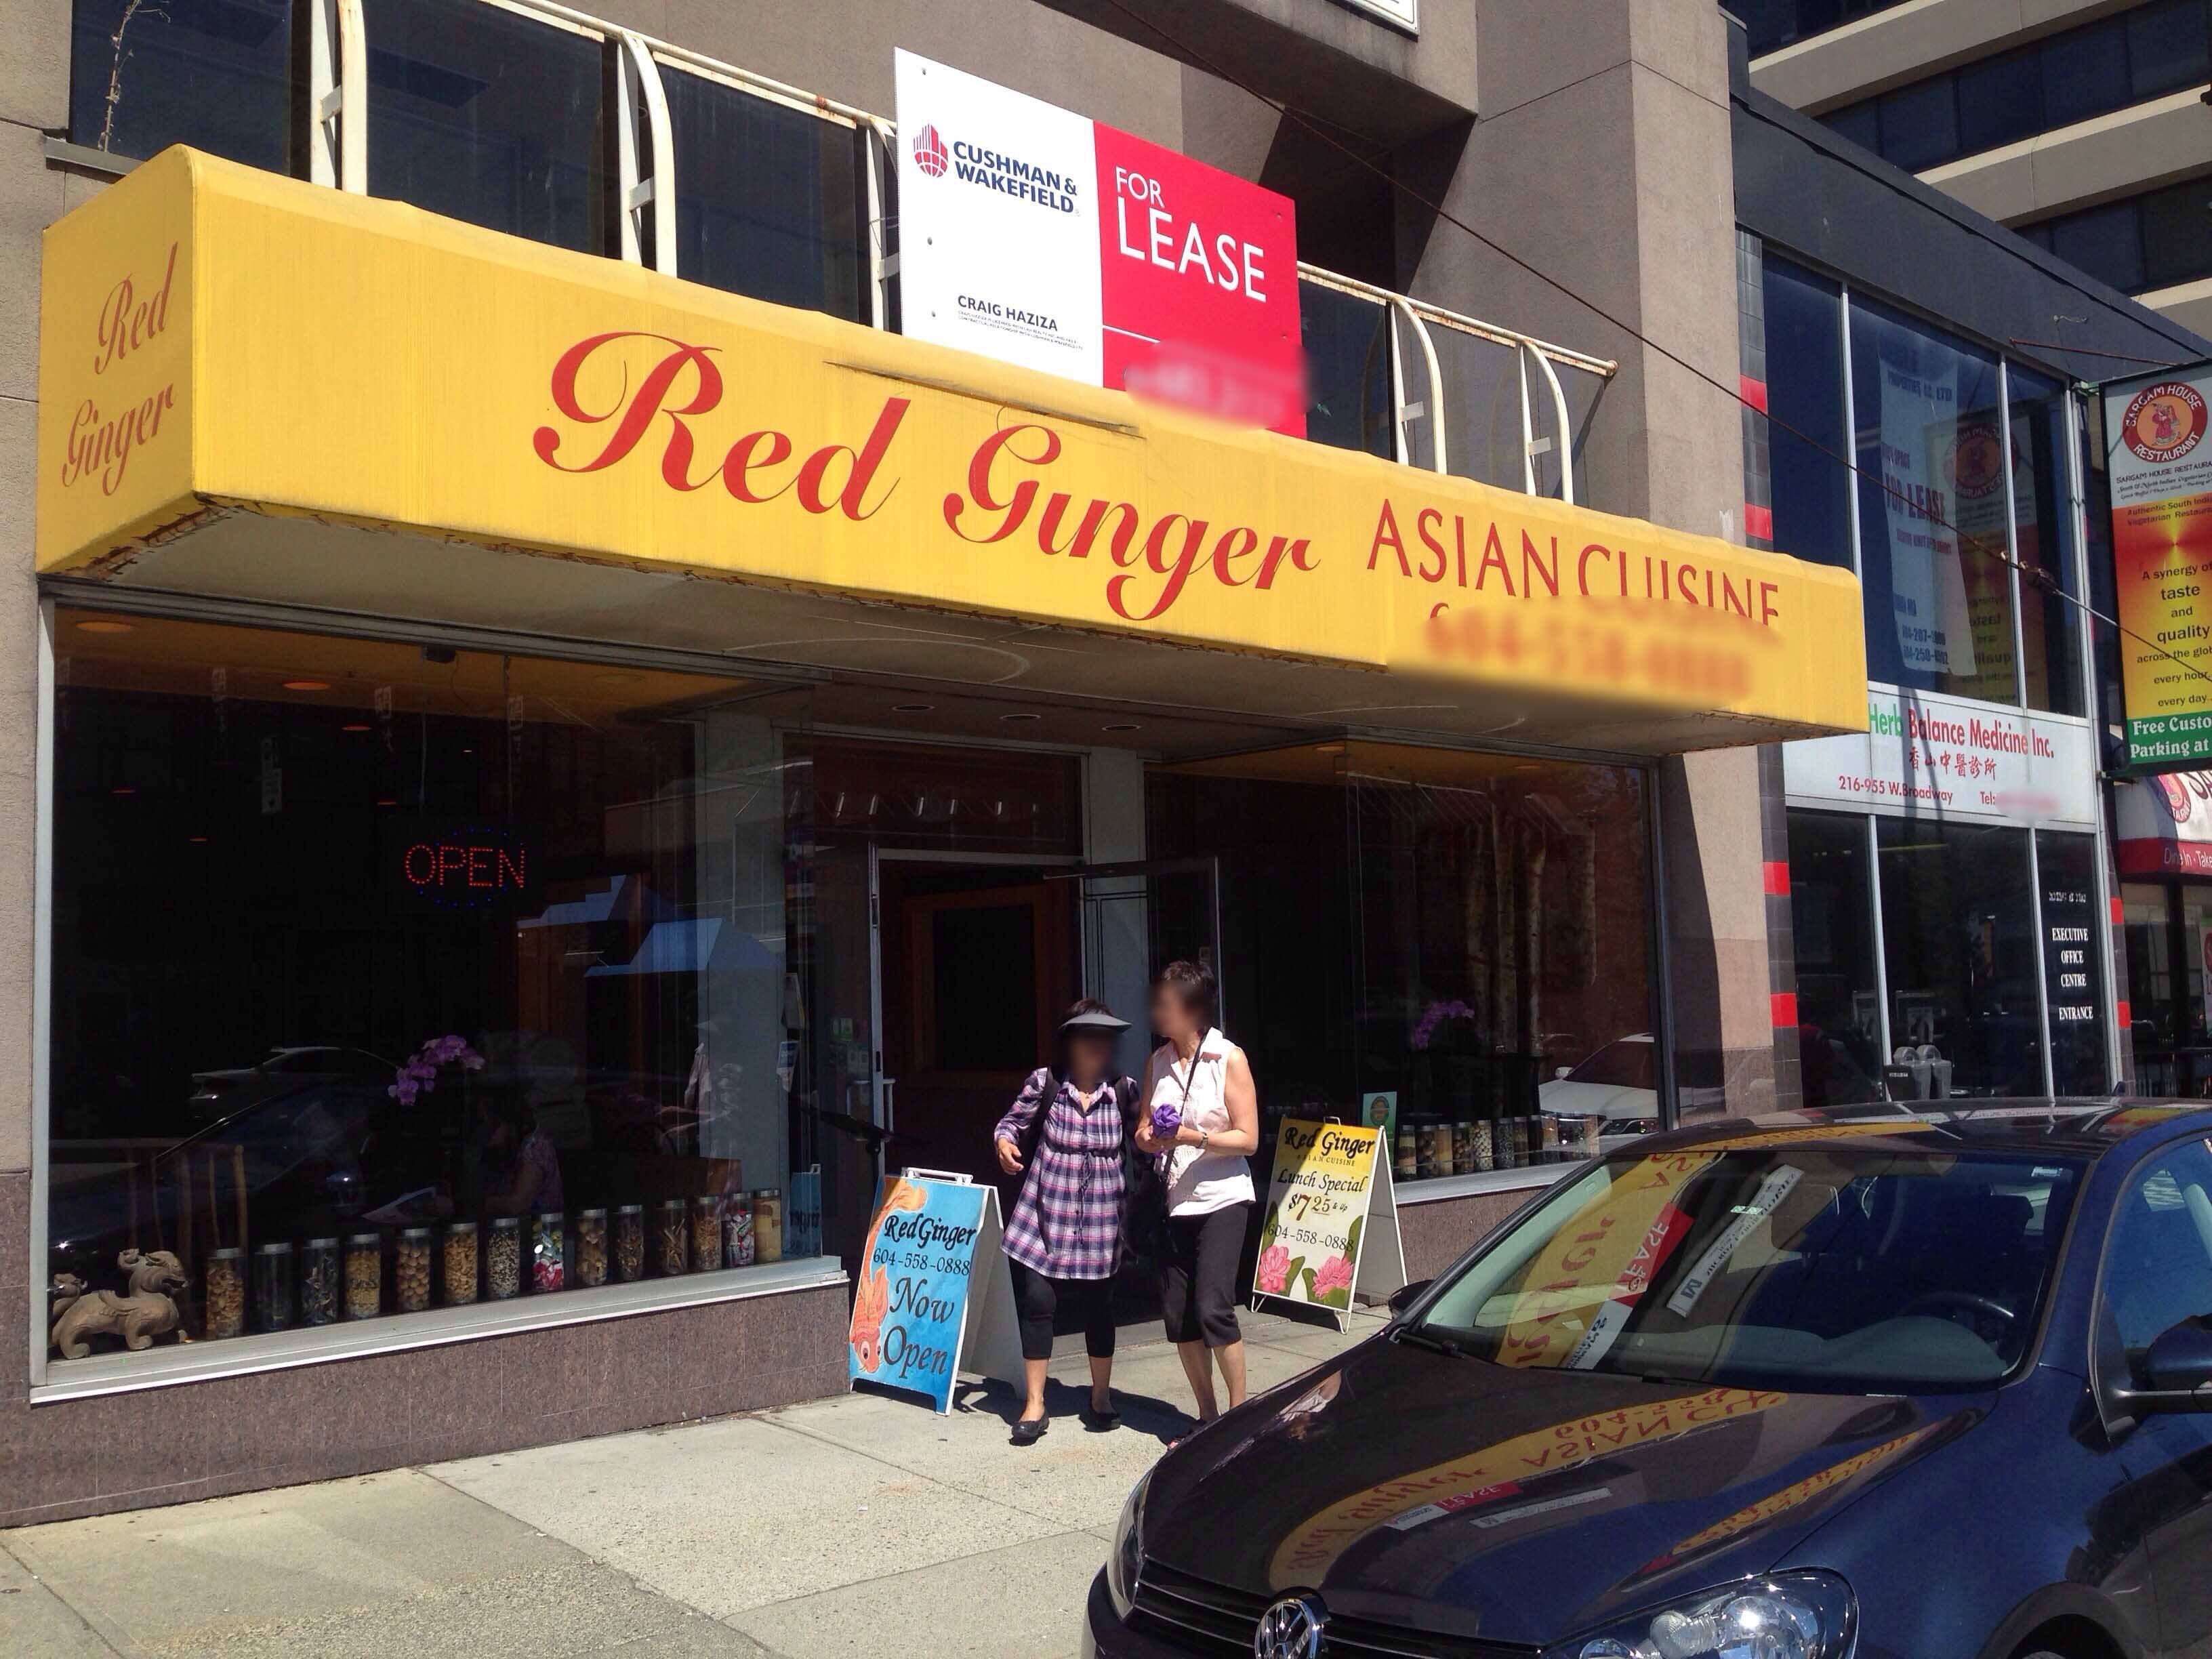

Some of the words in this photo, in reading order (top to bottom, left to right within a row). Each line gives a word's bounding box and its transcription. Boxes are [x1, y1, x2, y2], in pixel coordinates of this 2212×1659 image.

[954, 141, 1060, 190] CUSHMAN
[1064, 178, 1078, 196] &
[955, 161, 1073, 213] WAKEFIELD
[1115, 165, 1165, 208] FOR
[1118, 195, 1267, 303] LEASE
[95, 241, 178, 375] Red
[958, 295, 1001, 316] CRAIG
[1006, 307, 1058, 331] HAZIZA
[2125, 386, 2165, 427] SARGAM
[2167, 385, 2202, 410] HOUSE
[62, 383, 174, 496] Ginger
[2133, 431, 2200, 462] RESTAURANT
[533, 332, 911, 521] Red
[943, 406, 1321, 621] Ginger
[1366, 499, 1558, 598] ASIAN
[1578, 544, 1779, 626] CUISINE
[2116, 472, 2147, 484] SARGAM
[2149, 468, 2172, 478] HOUSE
[2128, 504, 2167, 515] Authentic
[2168, 499, 2192, 510] South
[2142, 571, 2150, 581] A
[2153, 565, 2198, 580] synergy
[2160, 584, 2201, 601] taste
[2171, 606, 2193, 617] and
[2157, 625, 2210, 644] quality
[2137, 651, 2170, 663] across
[2173, 649, 2190, 660] the
[2154, 674, 2182, 684] every
[2158, 697, 2186, 706] every
[1868, 703, 1903, 737] Herb
[1908, 709, 1965, 746] Balance
[1970, 718, 2028, 755] Medicine
[2032, 729, 2055, 758] Inc.
[2133, 720, 2165, 735] Free
[2130, 741, 2190, 758] Parking
[2194, 737, 2209, 752] at
[1839, 775, 1885, 794] 216-955
[1888, 781, 1953, 805] W.Broadway
[405, 844, 525, 888] OPEN
[2052, 927, 2089, 941] EXECUTIVE
[2061, 950, 2084, 964] OFFICE
[2061, 973, 2087, 987] CENTRE
[2059, 1006, 2093, 1021] ENTRANCE
[1285, 1126, 1322, 1149] Red
[1321, 1131, 1376, 1159] Ginger
[1326, 1156, 1356, 1166] CUISINE
[1277, 1168, 1317, 1187] Lunch
[1319, 1174, 1368, 1195] Special
[1268, 1225, 1354, 1252] 604-558-0888
[873, 1248, 970, 1275] 604-558-0888
[890, 1277, 955, 1324] Now
[883, 1326, 948, 1378] Open
